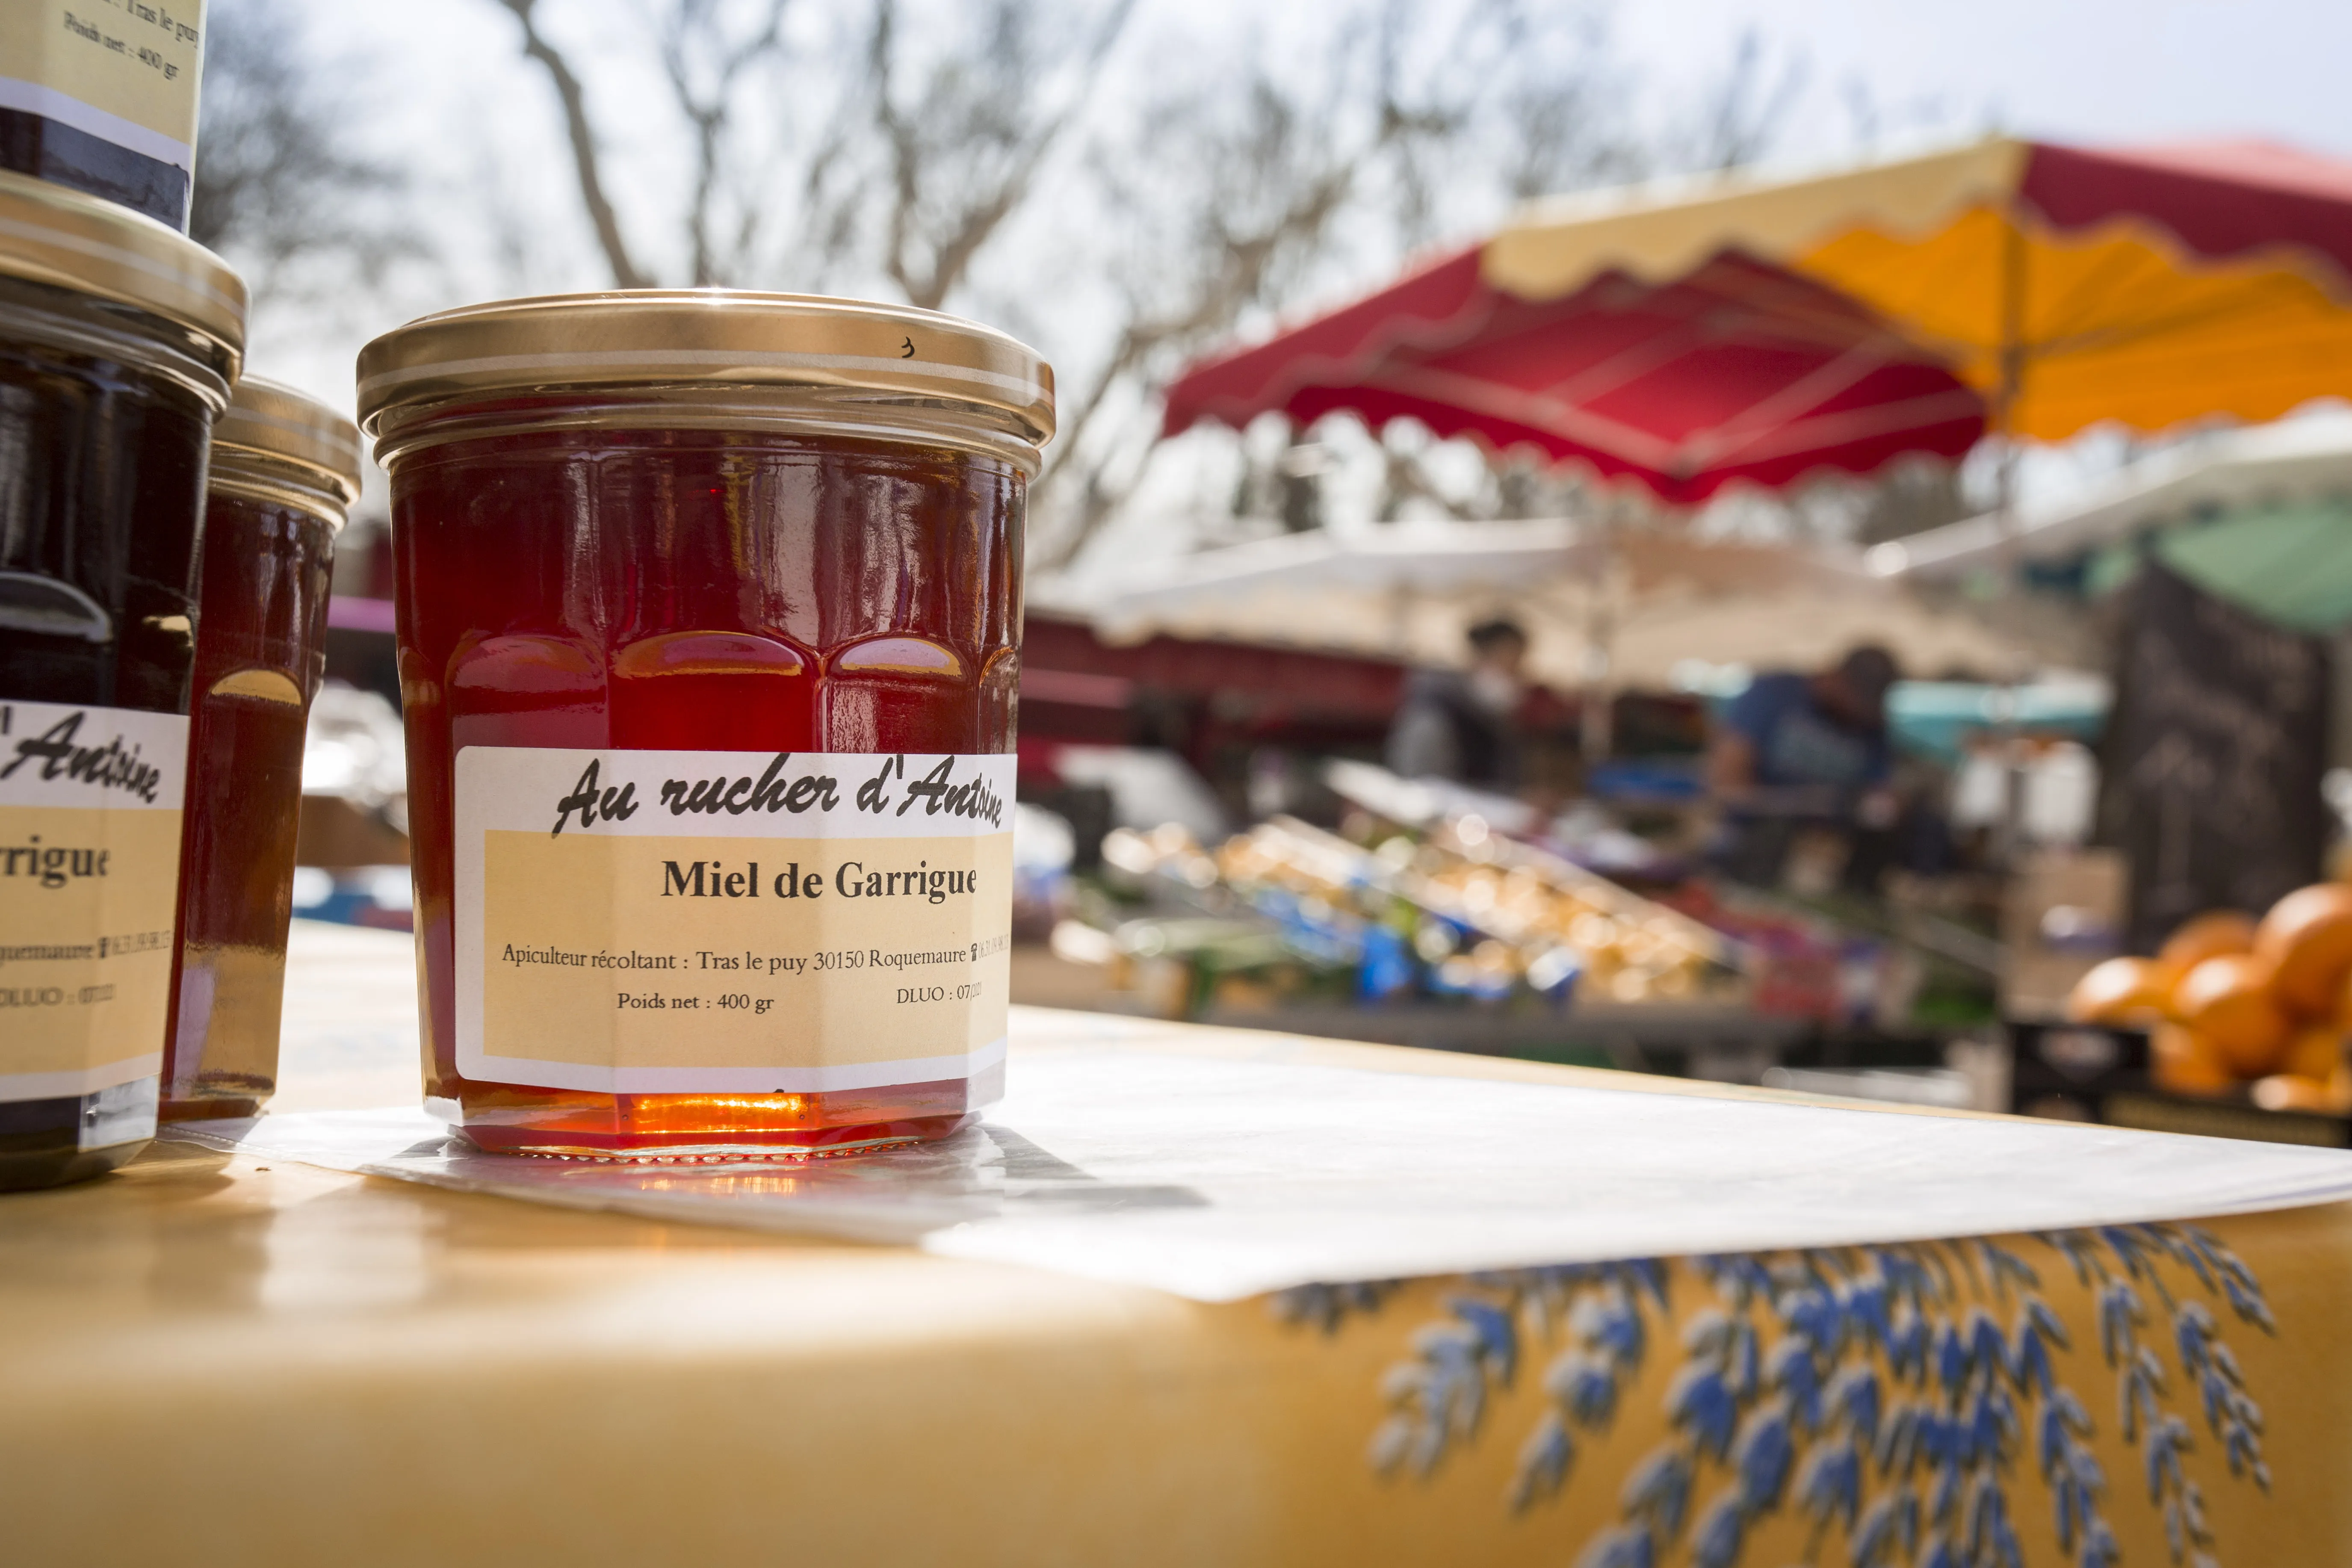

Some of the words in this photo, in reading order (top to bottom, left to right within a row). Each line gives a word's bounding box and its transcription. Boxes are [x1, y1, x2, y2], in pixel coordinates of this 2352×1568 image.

[137, 46, 162, 69] 400
[551, 758, 639, 839] Au
[660, 752, 839, 815] rucher
[856, 754, 1002, 829] d'Antoine
[660, 861, 760, 898] Miel
[774, 862, 823, 899] de
[836, 860, 977, 904] Garrigue
[502, 944, 588, 967] Apiculteur
[591, 950, 677, 969] récoltant
[696, 951, 739, 970] Tras
[745, 951, 763, 970] le
[769, 957, 808, 975] puy
[813, 951, 864, 971] 30150
[869, 949, 966, 971] Roquemaure
[617, 992, 666, 1009] Poids
[671, 996, 700, 1009] net
[717, 993, 751, 1009] 400
[755, 999, 774, 1014] gr
[897, 986, 944, 1004] DLUO
